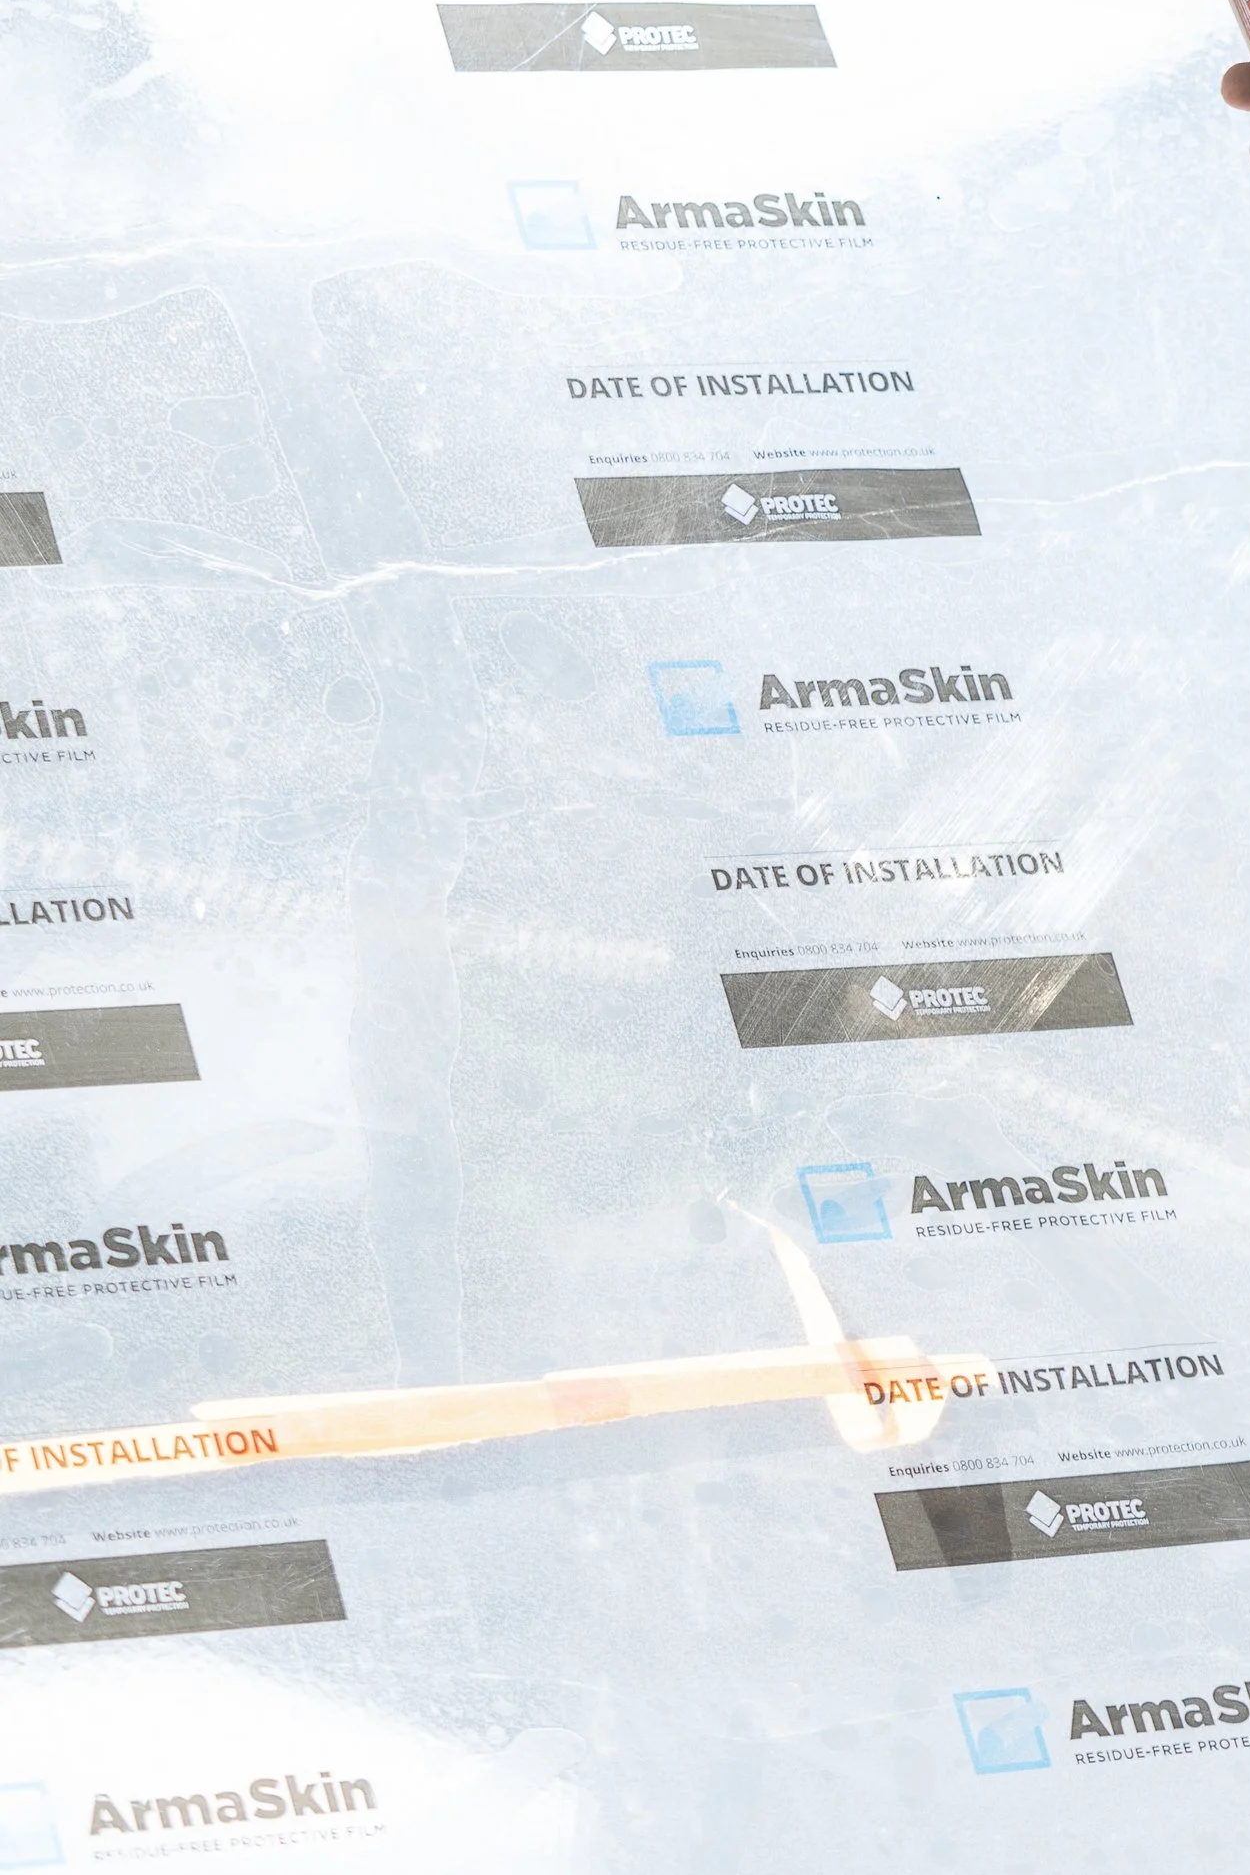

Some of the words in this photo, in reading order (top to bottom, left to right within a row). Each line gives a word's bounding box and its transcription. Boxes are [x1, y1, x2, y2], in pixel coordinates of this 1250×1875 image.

[618, 25, 698, 45] PROTEC
[616, 192, 867, 230] ArmaSkin
[620, 239, 734, 252] RESIDUE-FREE
[738, 237, 835, 251] PROTECTIVE
[839, 236, 875, 249] FILM
[566, 376, 644, 401] DATE
[650, 374, 688, 398] OF
[697, 370, 916, 397] INSTALLATION
[589, 453, 648, 467] Enquiries
[709, 450, 731, 462] 704
[753, 447, 807, 460] Website
[760, 493, 839, 514] PROTEC
[759, 665, 1013, 710] ArmaSkin
[764, 718, 879, 733] RESIDUE-FREE
[883, 715, 984, 730] PROTECTIVE
[986, 713, 1023, 725] FILM
[57, 750, 97, 762] FILM
[710, 864, 790, 891] DATE
[796, 862, 835, 887] OF
[843, 852, 1065, 885] INSTALLATION
[735, 947, 795, 961] Enquiries
[797, 944, 828, 956] 0800
[831, 943, 854, 955] 834
[857, 941, 879, 953] 704
[901, 937, 954, 951] Website
[957, 931, 1087, 949] www.protection.co.uk
[12, 981, 154, 998] www.protection.co.uk
[909, 986, 988, 1008] PROTEC
[911, 1161, 1168, 1214] ArmaSkin
[916, 1218, 1034, 1238] RESIDUE-FREE
[1038, 1212, 1136, 1230] PROTECTIVE
[1140, 1208, 1178, 1223] FILM
[84, 1277, 192, 1295] PROTECTIVE
[199, 1275, 238, 1288] FILM
[864, 1378, 944, 1406] DATE
[950, 1373, 990, 1399] OF
[998, 1354, 1225, 1395] INSTALLATION
[30, 1428, 279, 1471] INSTALLATION
[889, 1462, 950, 1479] Enquiries
[951, 1458, 984, 1473] 0800
[986, 1456, 1009, 1471] 834
[1011, 1454, 1036, 1468] 704
[1057, 1447, 1112, 1464] Website
[1114, 1436, 1248, 1459] www.protection.co.uk
[1066, 1499, 1147, 1524] PROTEC
[92, 1528, 151, 1543] Website
[96, 1581, 187, 1607] PROTEC
[1075, 1743, 1193, 1765] RESIDUE-FREE
[90, 1771, 377, 1836] ArmaSkin
[230, 1828, 340, 1848] PROTECTIVE
[346, 1823, 386, 1838] FILM
